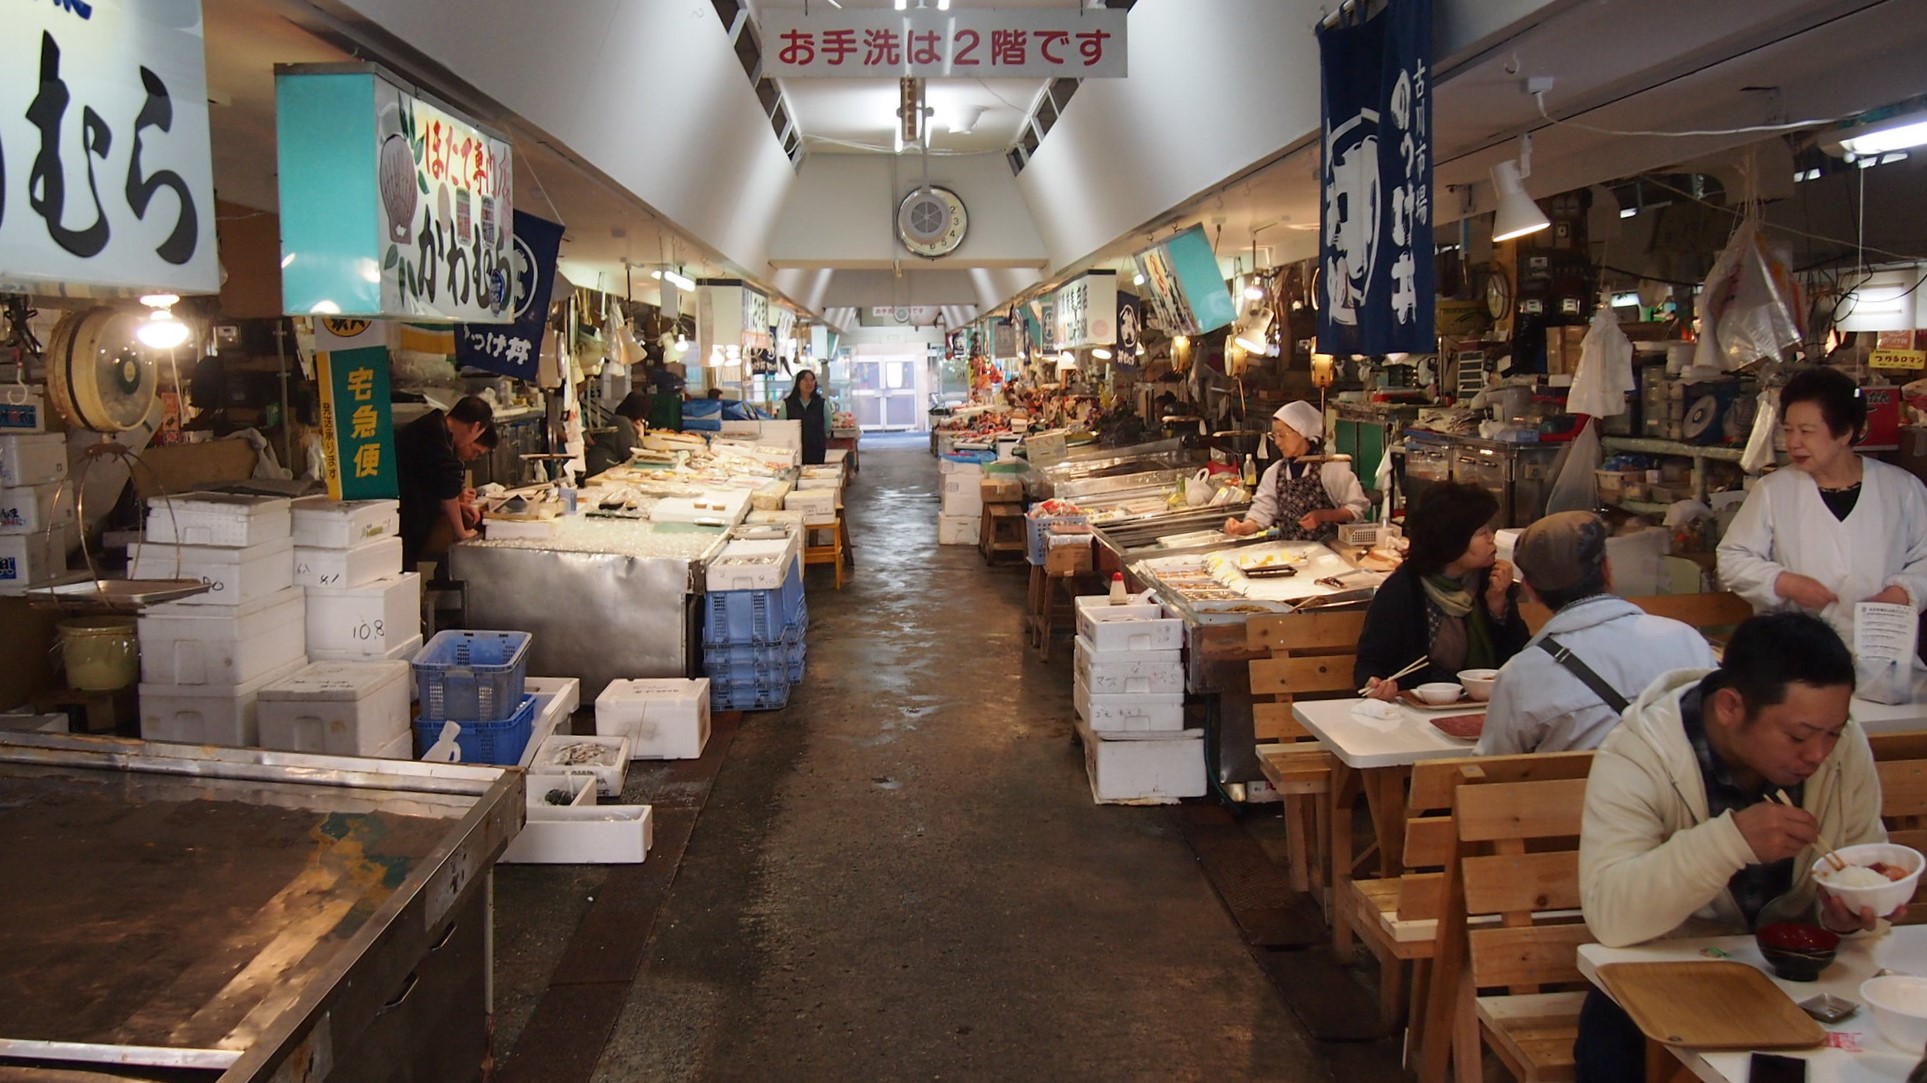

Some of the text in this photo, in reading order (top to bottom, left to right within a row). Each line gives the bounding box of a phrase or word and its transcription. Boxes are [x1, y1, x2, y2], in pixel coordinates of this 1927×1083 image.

[779, 29, 1111, 66] お手洗は2階です
[0, 29, 198, 265] むら
[425, 120, 511, 203] ほたて専門店
[1413, 58, 1428, 226] 古川市場
[418, 203, 511, 312] かわむら
[347, 367, 380, 478] 宅急便
[353, 619, 385, 640] 10.8
